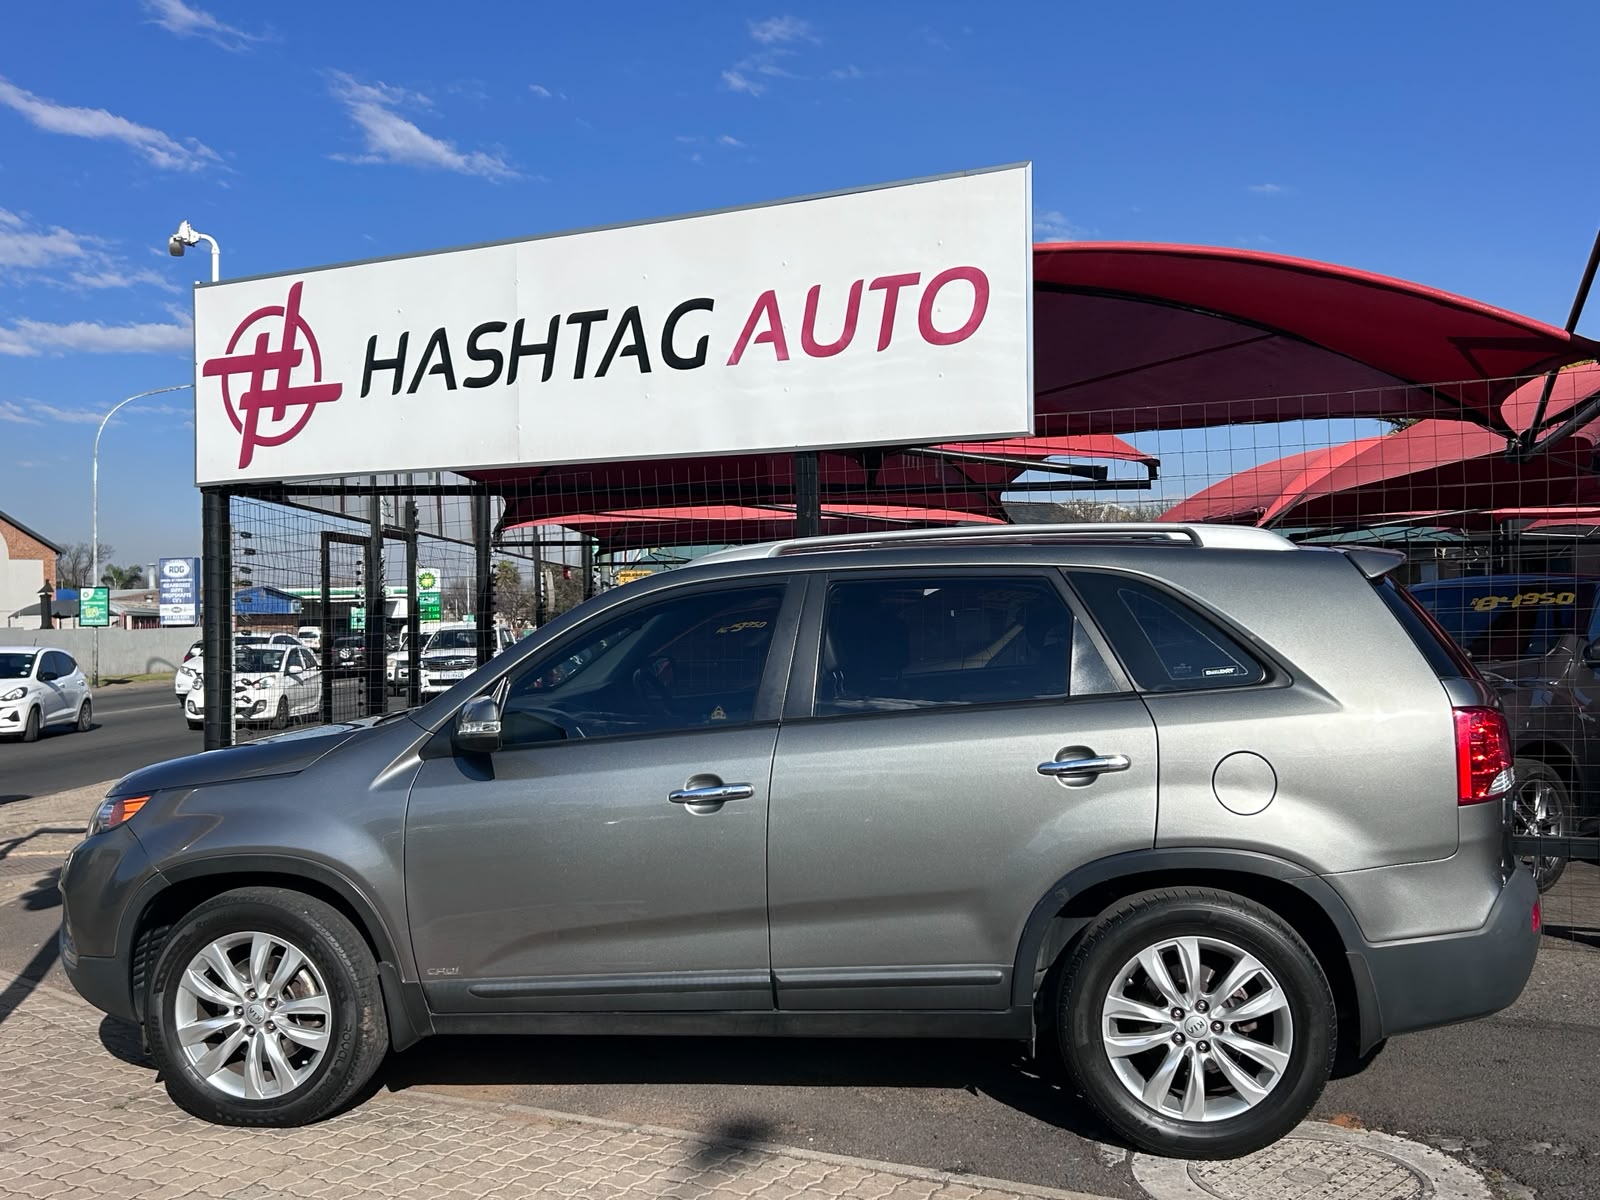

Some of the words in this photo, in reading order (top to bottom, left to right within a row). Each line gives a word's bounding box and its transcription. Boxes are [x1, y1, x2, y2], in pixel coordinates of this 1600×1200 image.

[360, 297, 715, 399] HASHTAG
[726, 266, 990, 366] AUTO
[168, 566, 185, 574] RDG
[1186, 1020, 1205, 1034] KIA
